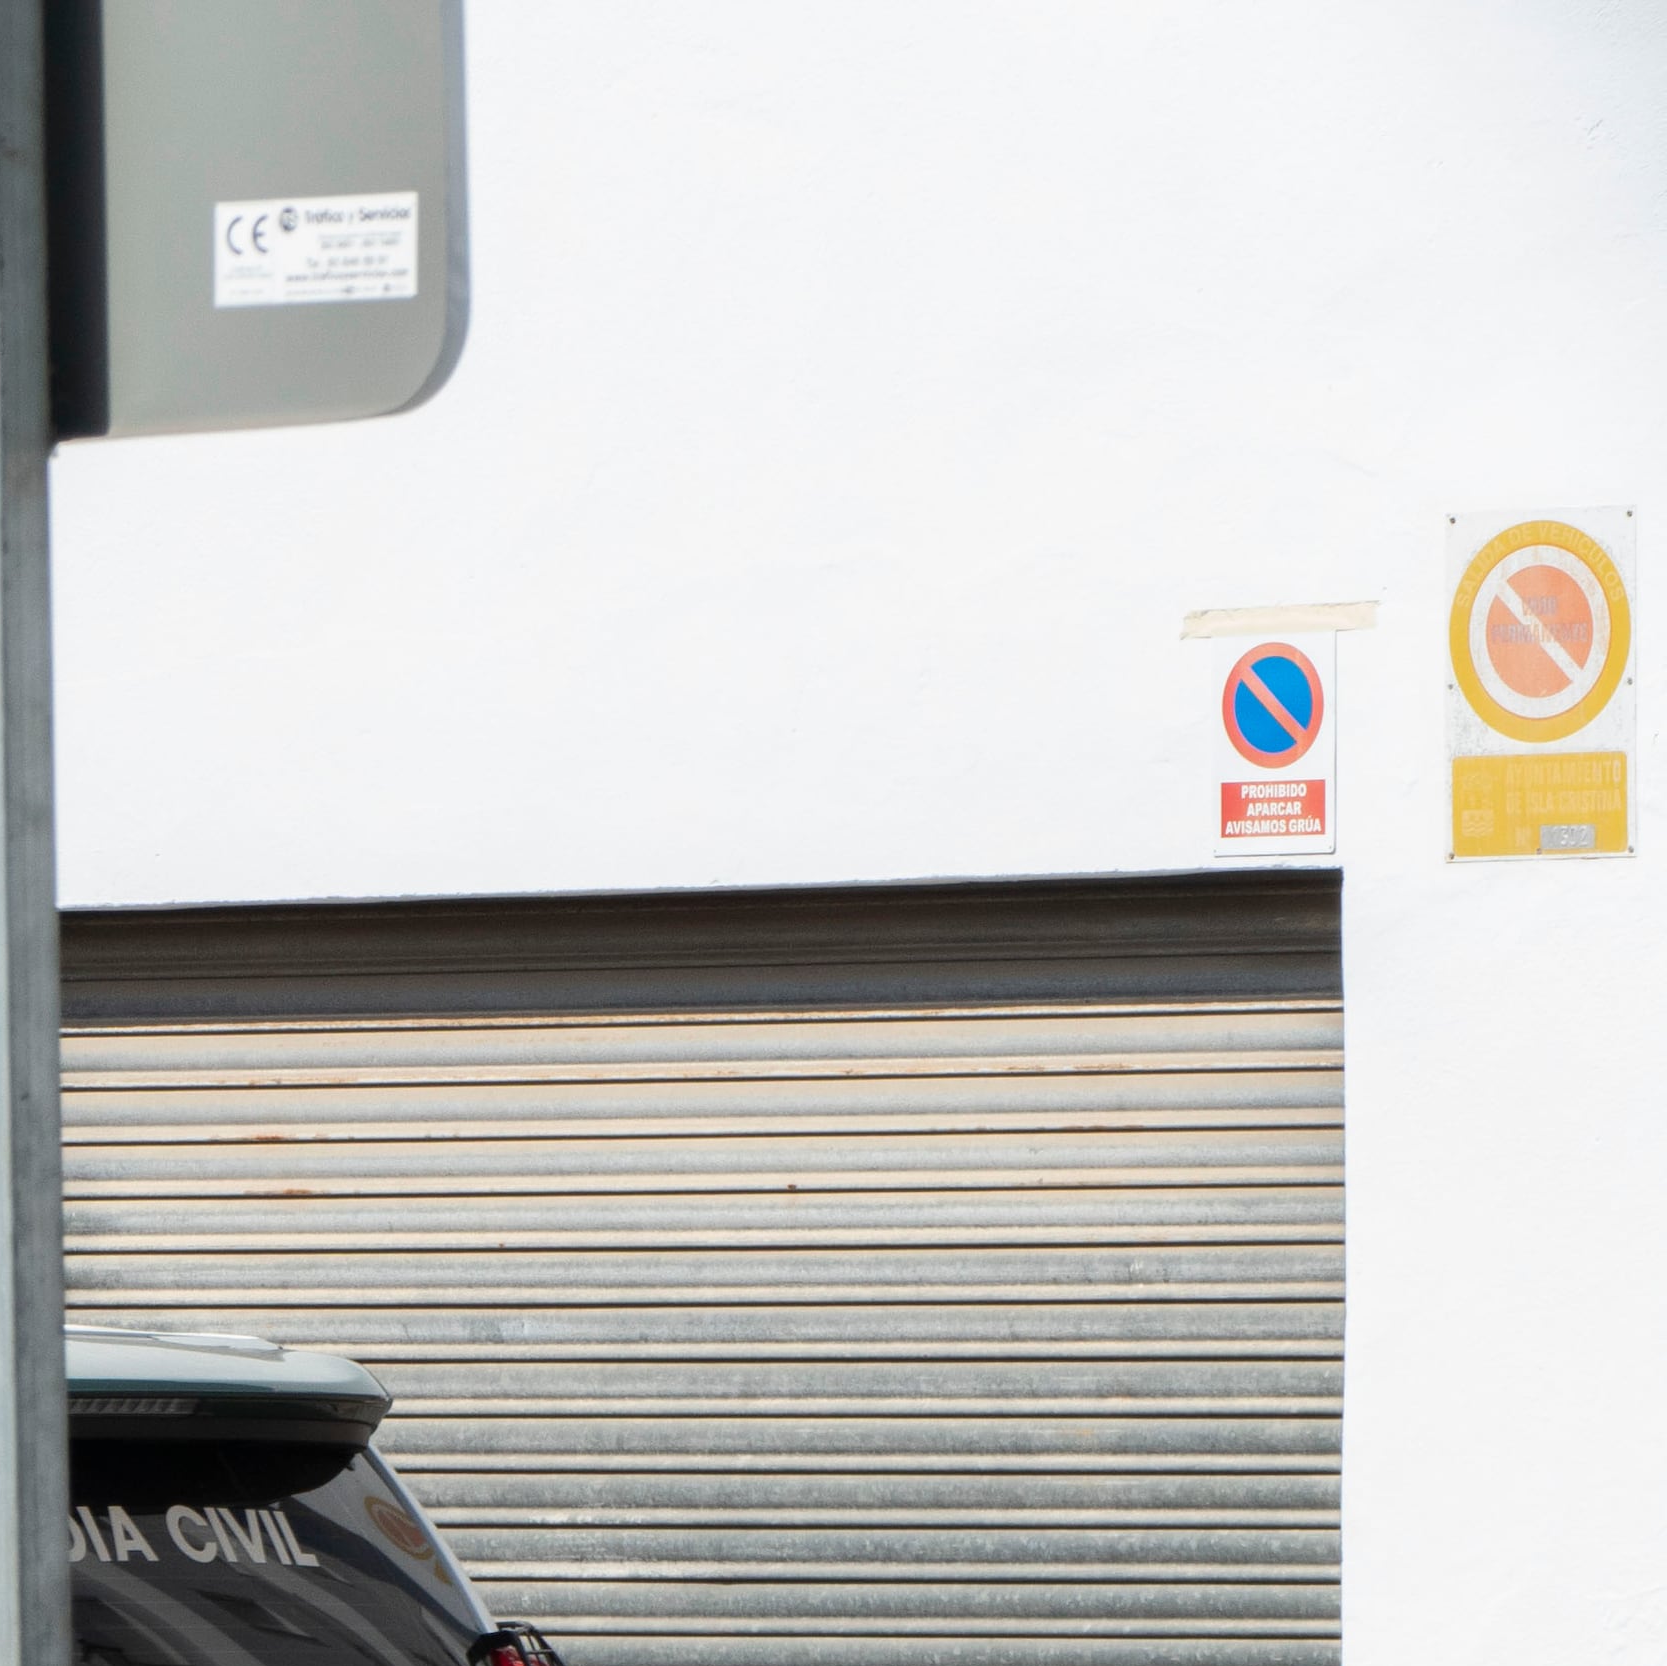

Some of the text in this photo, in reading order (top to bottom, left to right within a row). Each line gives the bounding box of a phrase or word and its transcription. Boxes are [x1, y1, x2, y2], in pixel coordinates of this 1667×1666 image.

[1457, 540, 1505, 608] SALIDA
[1241, 783, 1307, 799] PROHIBIDO
[1247, 801, 1302, 817] APARCAR
[1225, 816, 1322, 835] AVISAMOS GRÚA
[166, 1504, 320, 1567] CIVIL
